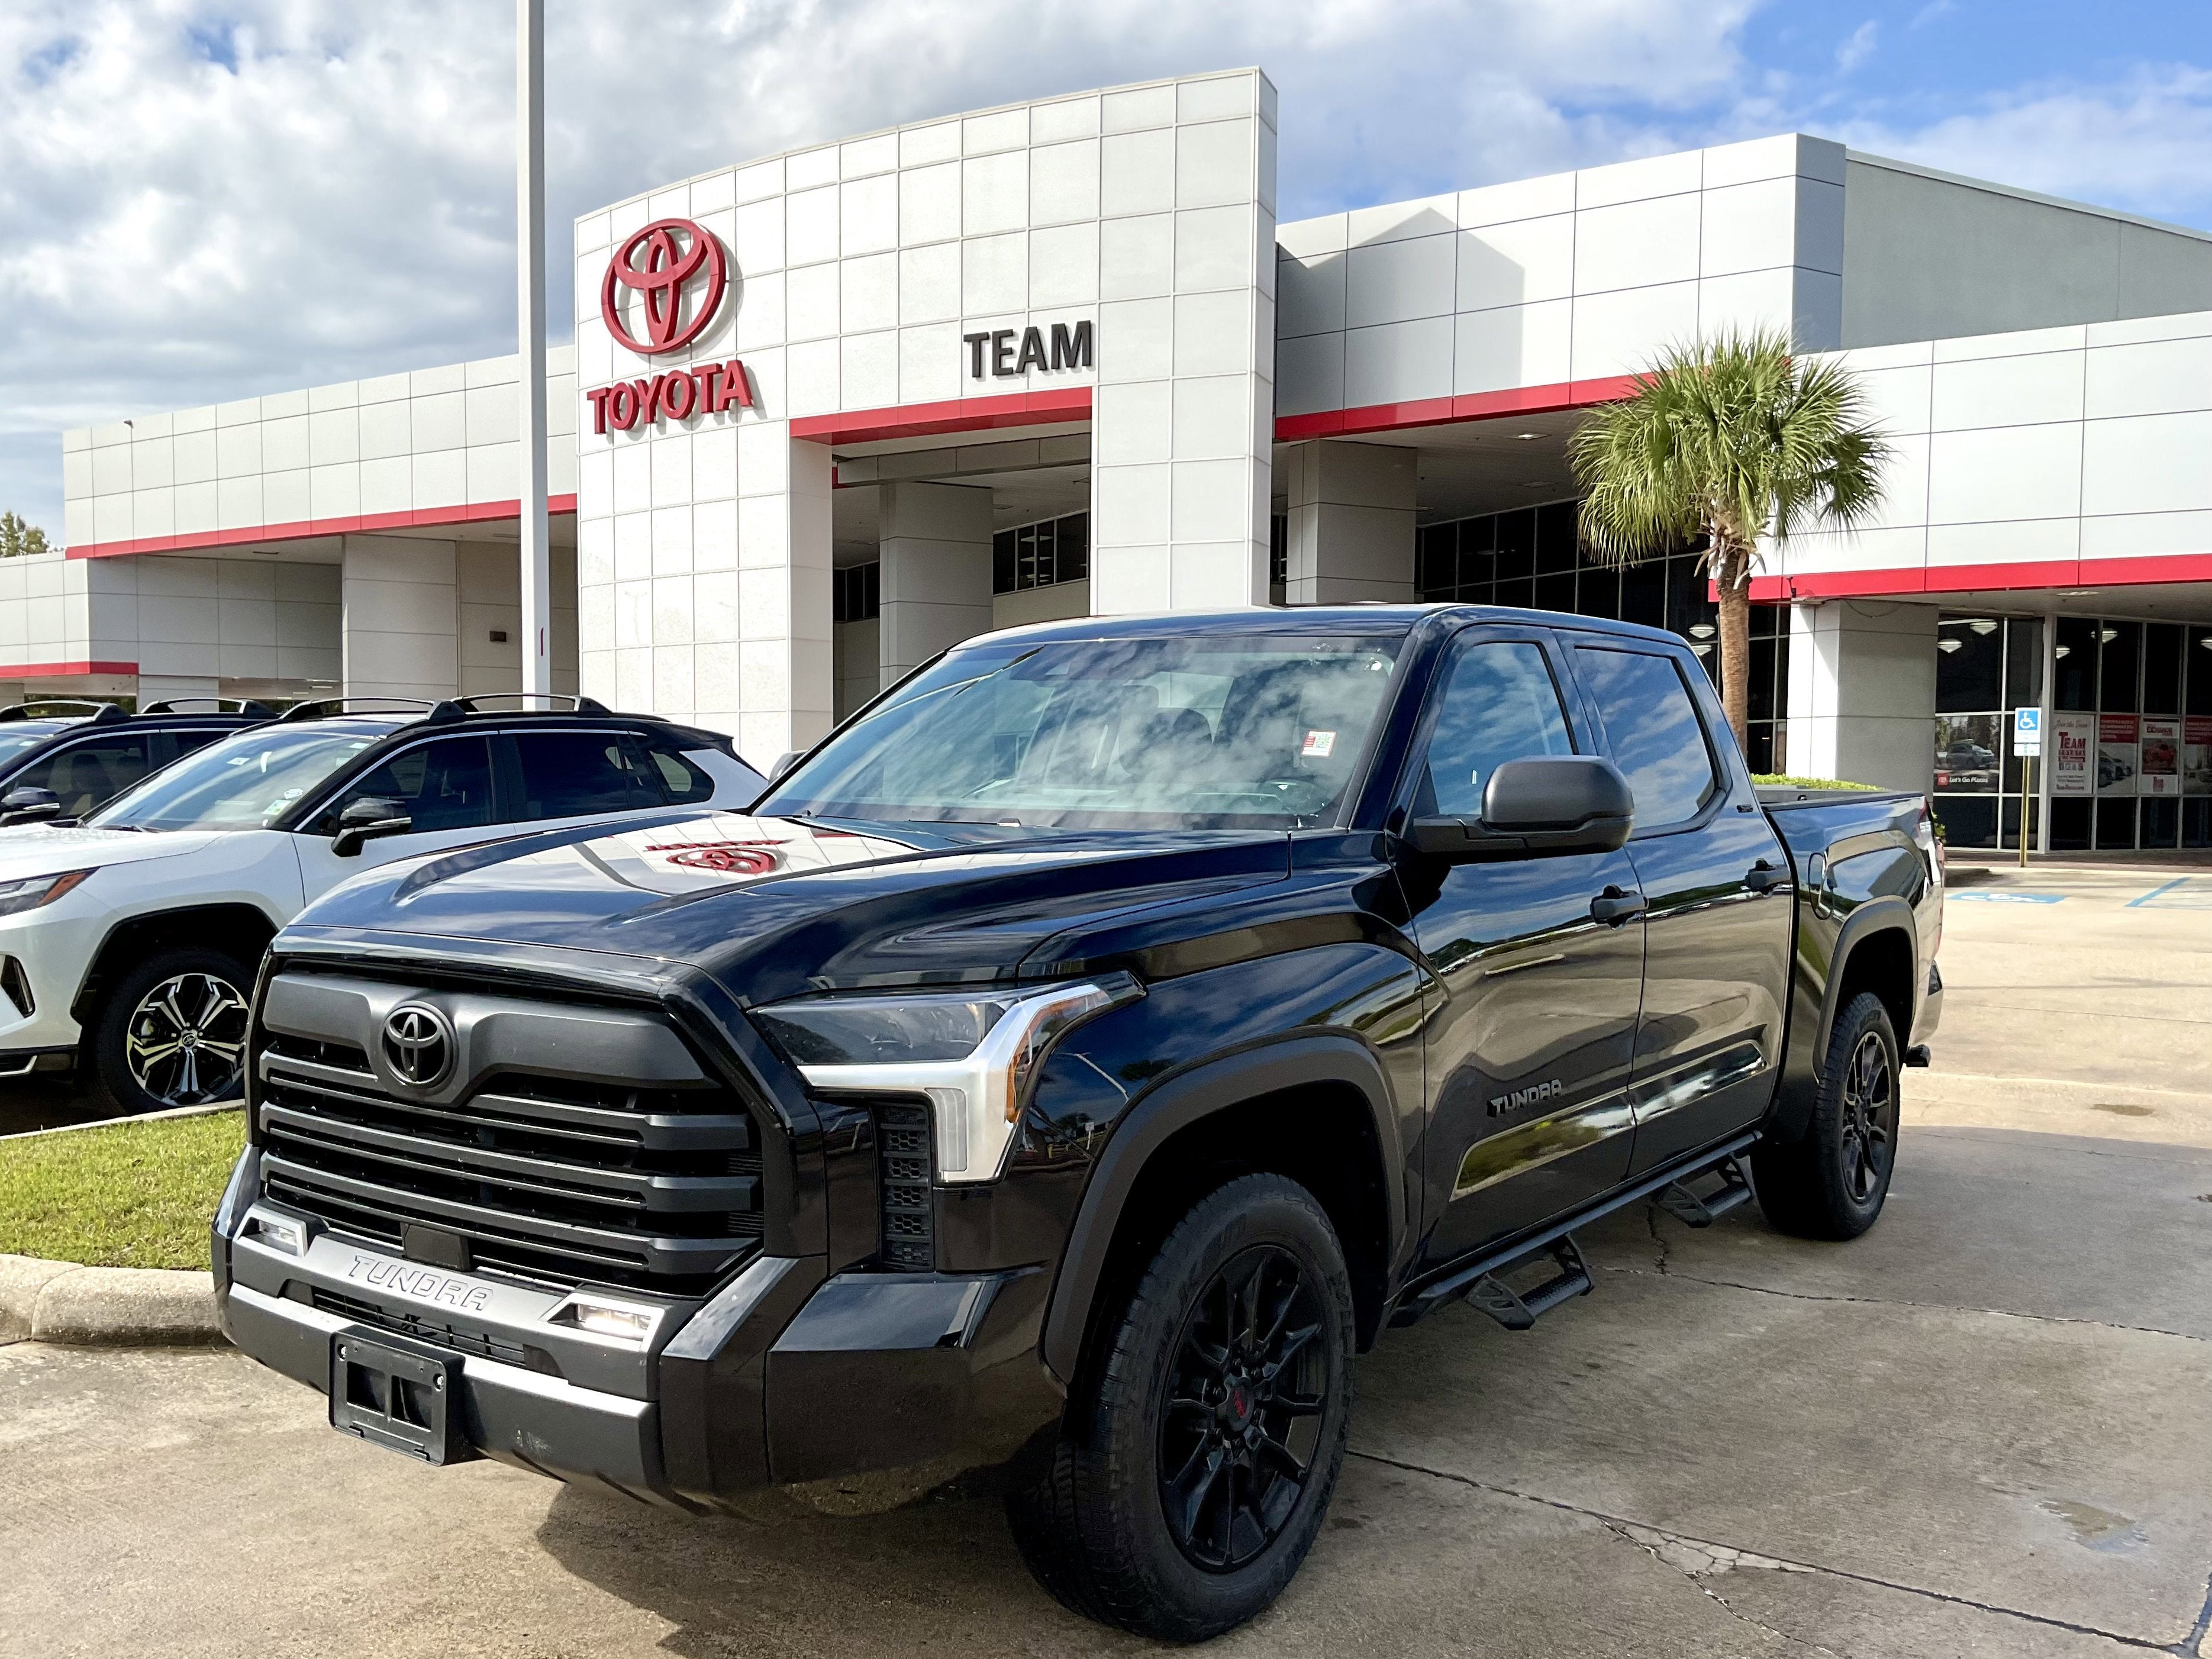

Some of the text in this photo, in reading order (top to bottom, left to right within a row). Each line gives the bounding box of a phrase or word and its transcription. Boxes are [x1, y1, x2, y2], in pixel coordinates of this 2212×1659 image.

[963, 320, 1091, 377] TEAM
[586, 359, 753, 434] TOYOTA
[2059, 732, 2086, 748] TEAM
[1488, 1079, 1562, 1115] TUNDRA
[349, 1255, 494, 1311] TUNDRA
